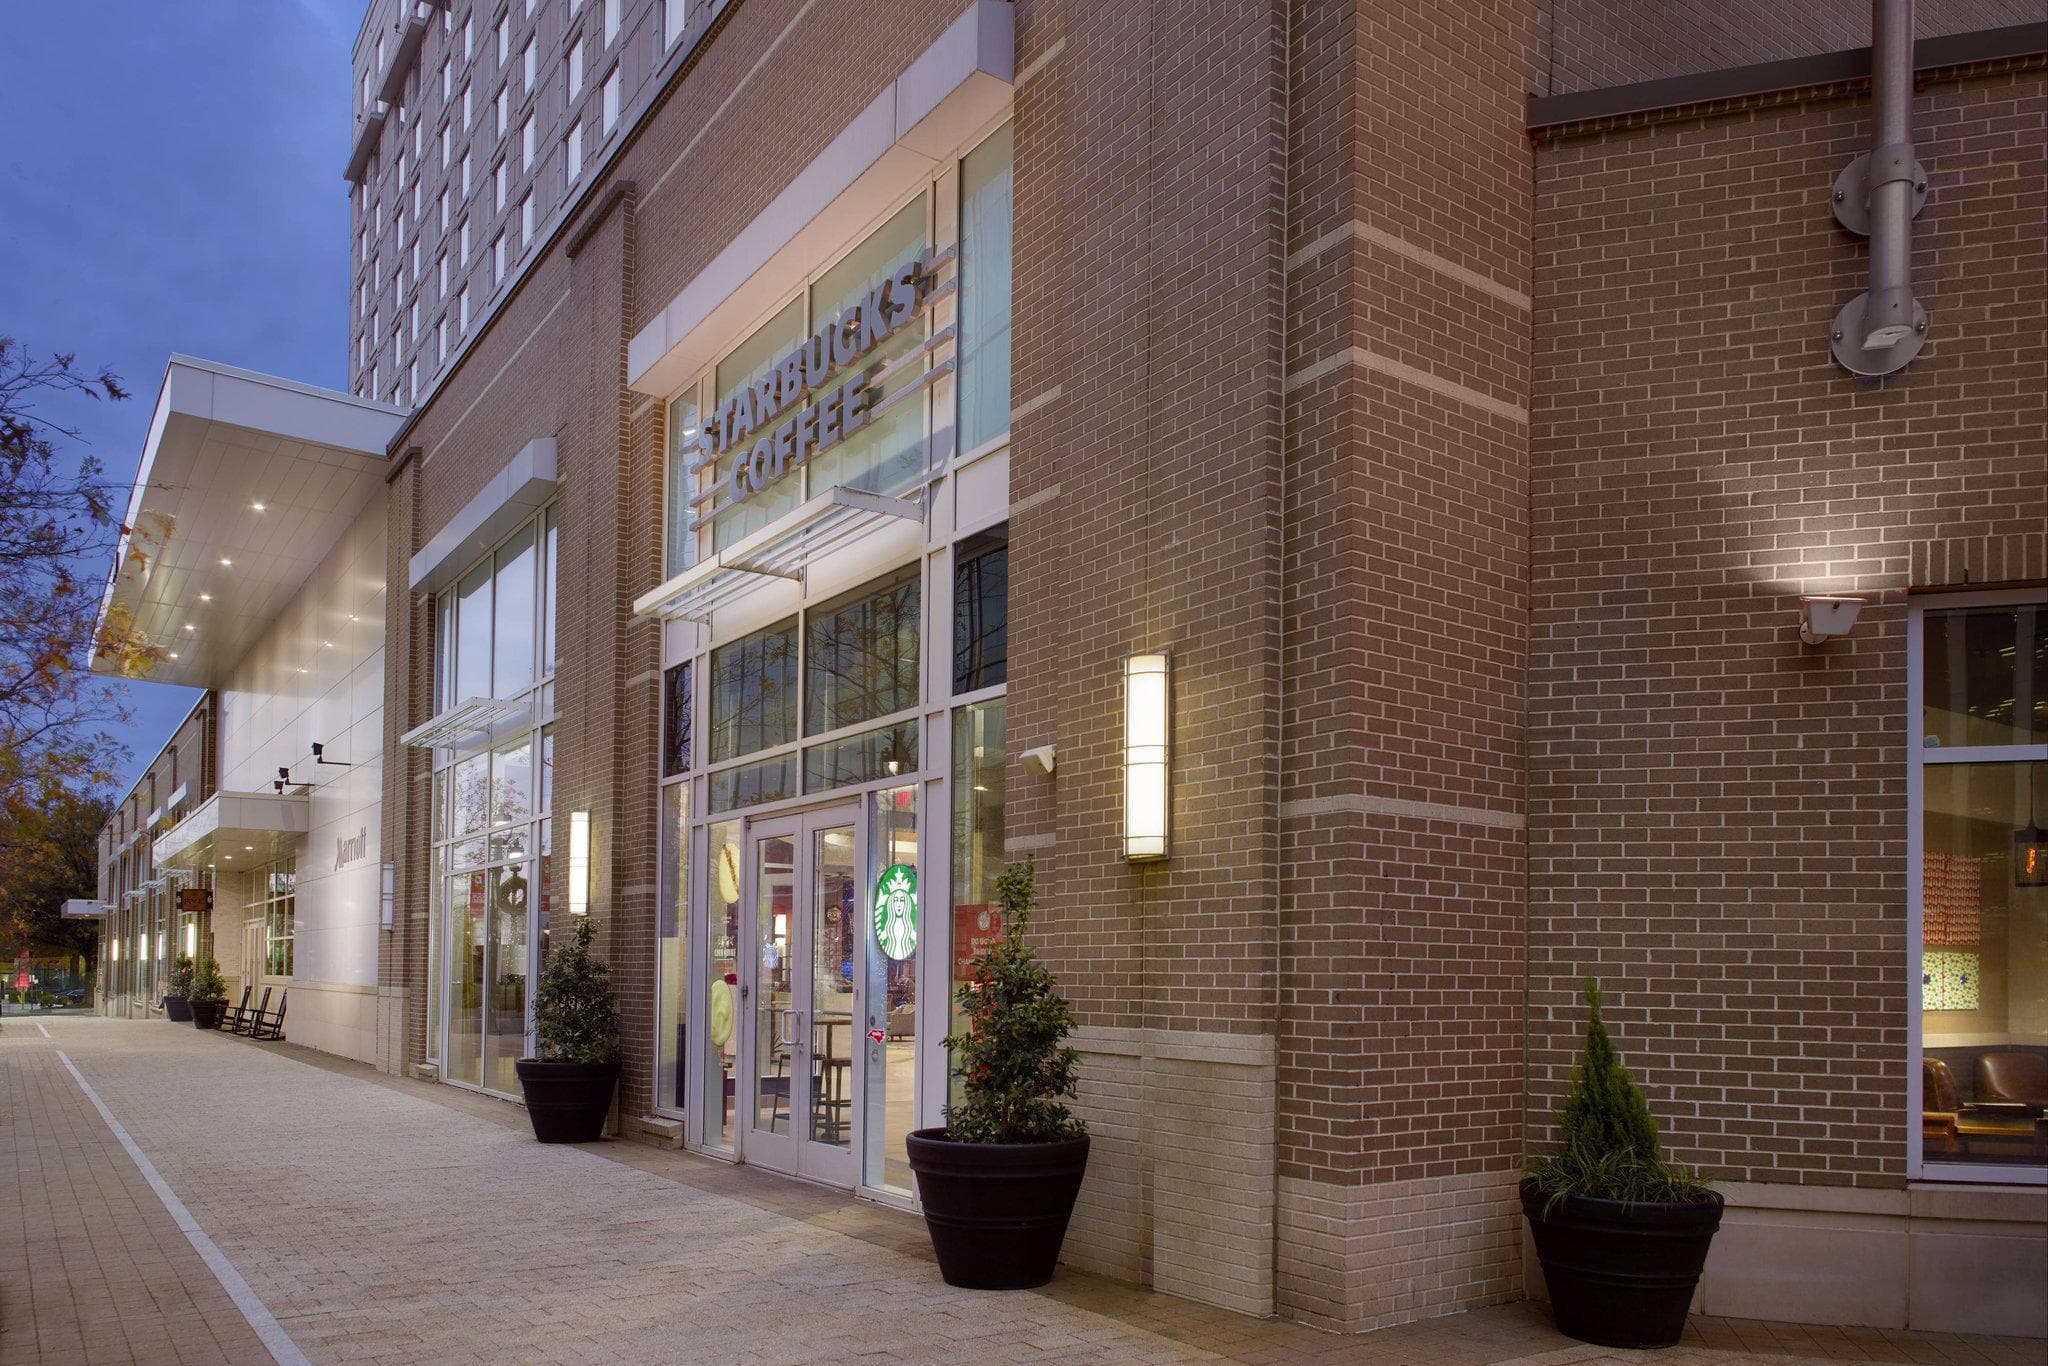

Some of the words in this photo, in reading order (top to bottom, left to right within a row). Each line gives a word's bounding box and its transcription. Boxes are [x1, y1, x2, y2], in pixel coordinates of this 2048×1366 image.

[698, 262, 922, 466] STARBUCKS
[730, 372, 869, 504] COFFEE
[334, 826, 367, 872] Marriott
